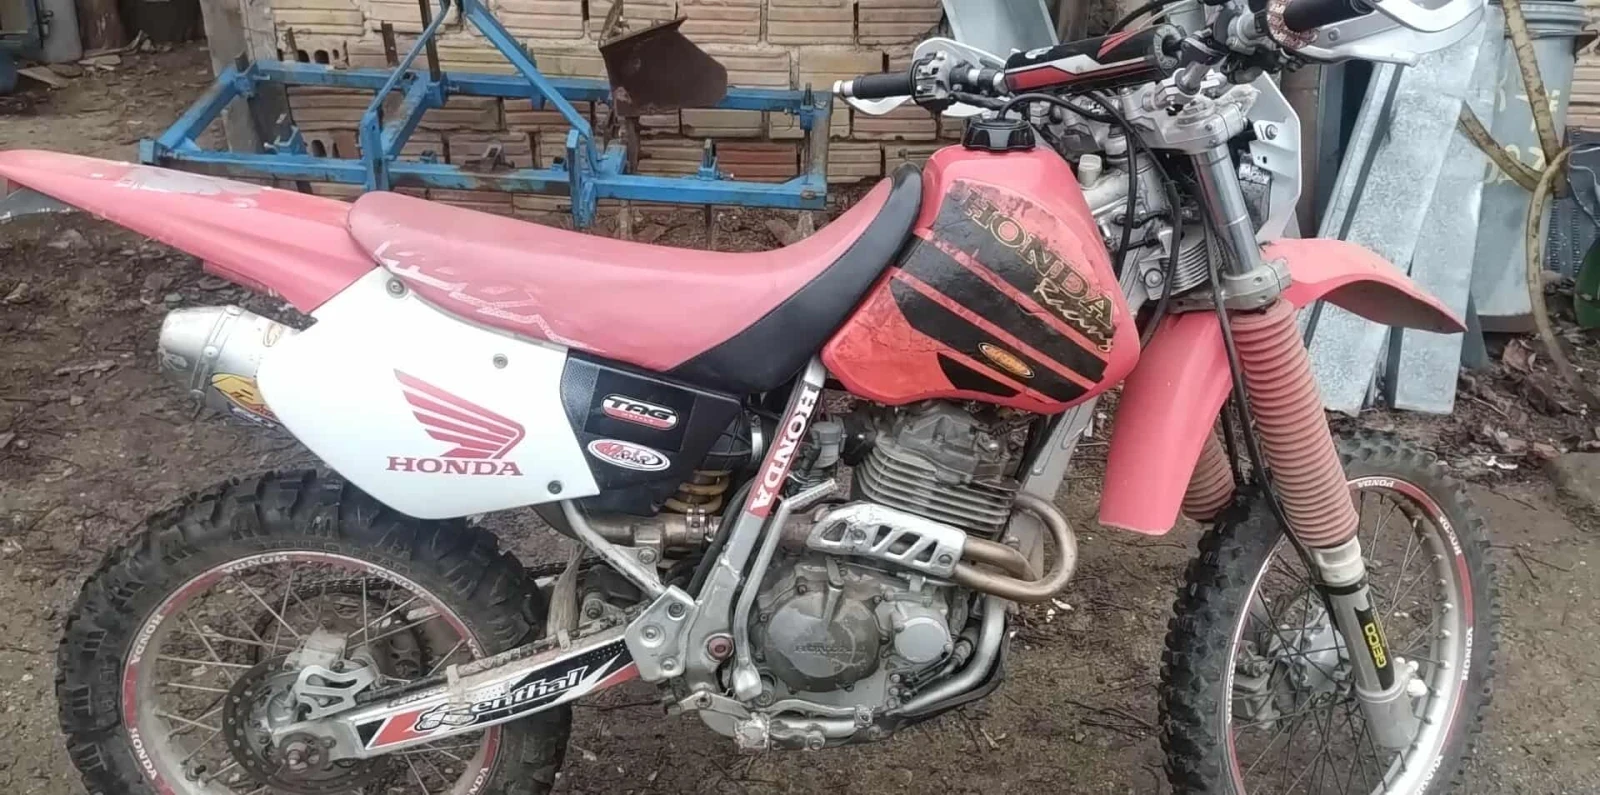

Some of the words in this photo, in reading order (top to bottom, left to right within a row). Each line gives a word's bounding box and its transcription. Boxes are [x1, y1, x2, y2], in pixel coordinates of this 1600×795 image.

[962, 187, 1113, 330] HONDA
[1033, 277, 1113, 353] Racing
[606, 397, 676, 421] TAG
[386, 456, 524, 476] HONDA
[750, 385, 819, 511] HONDA
[130, 614, 165, 665] HONDA
[1364, 622, 1388, 668] GEICO
[129, 727, 158, 780] HONDA
